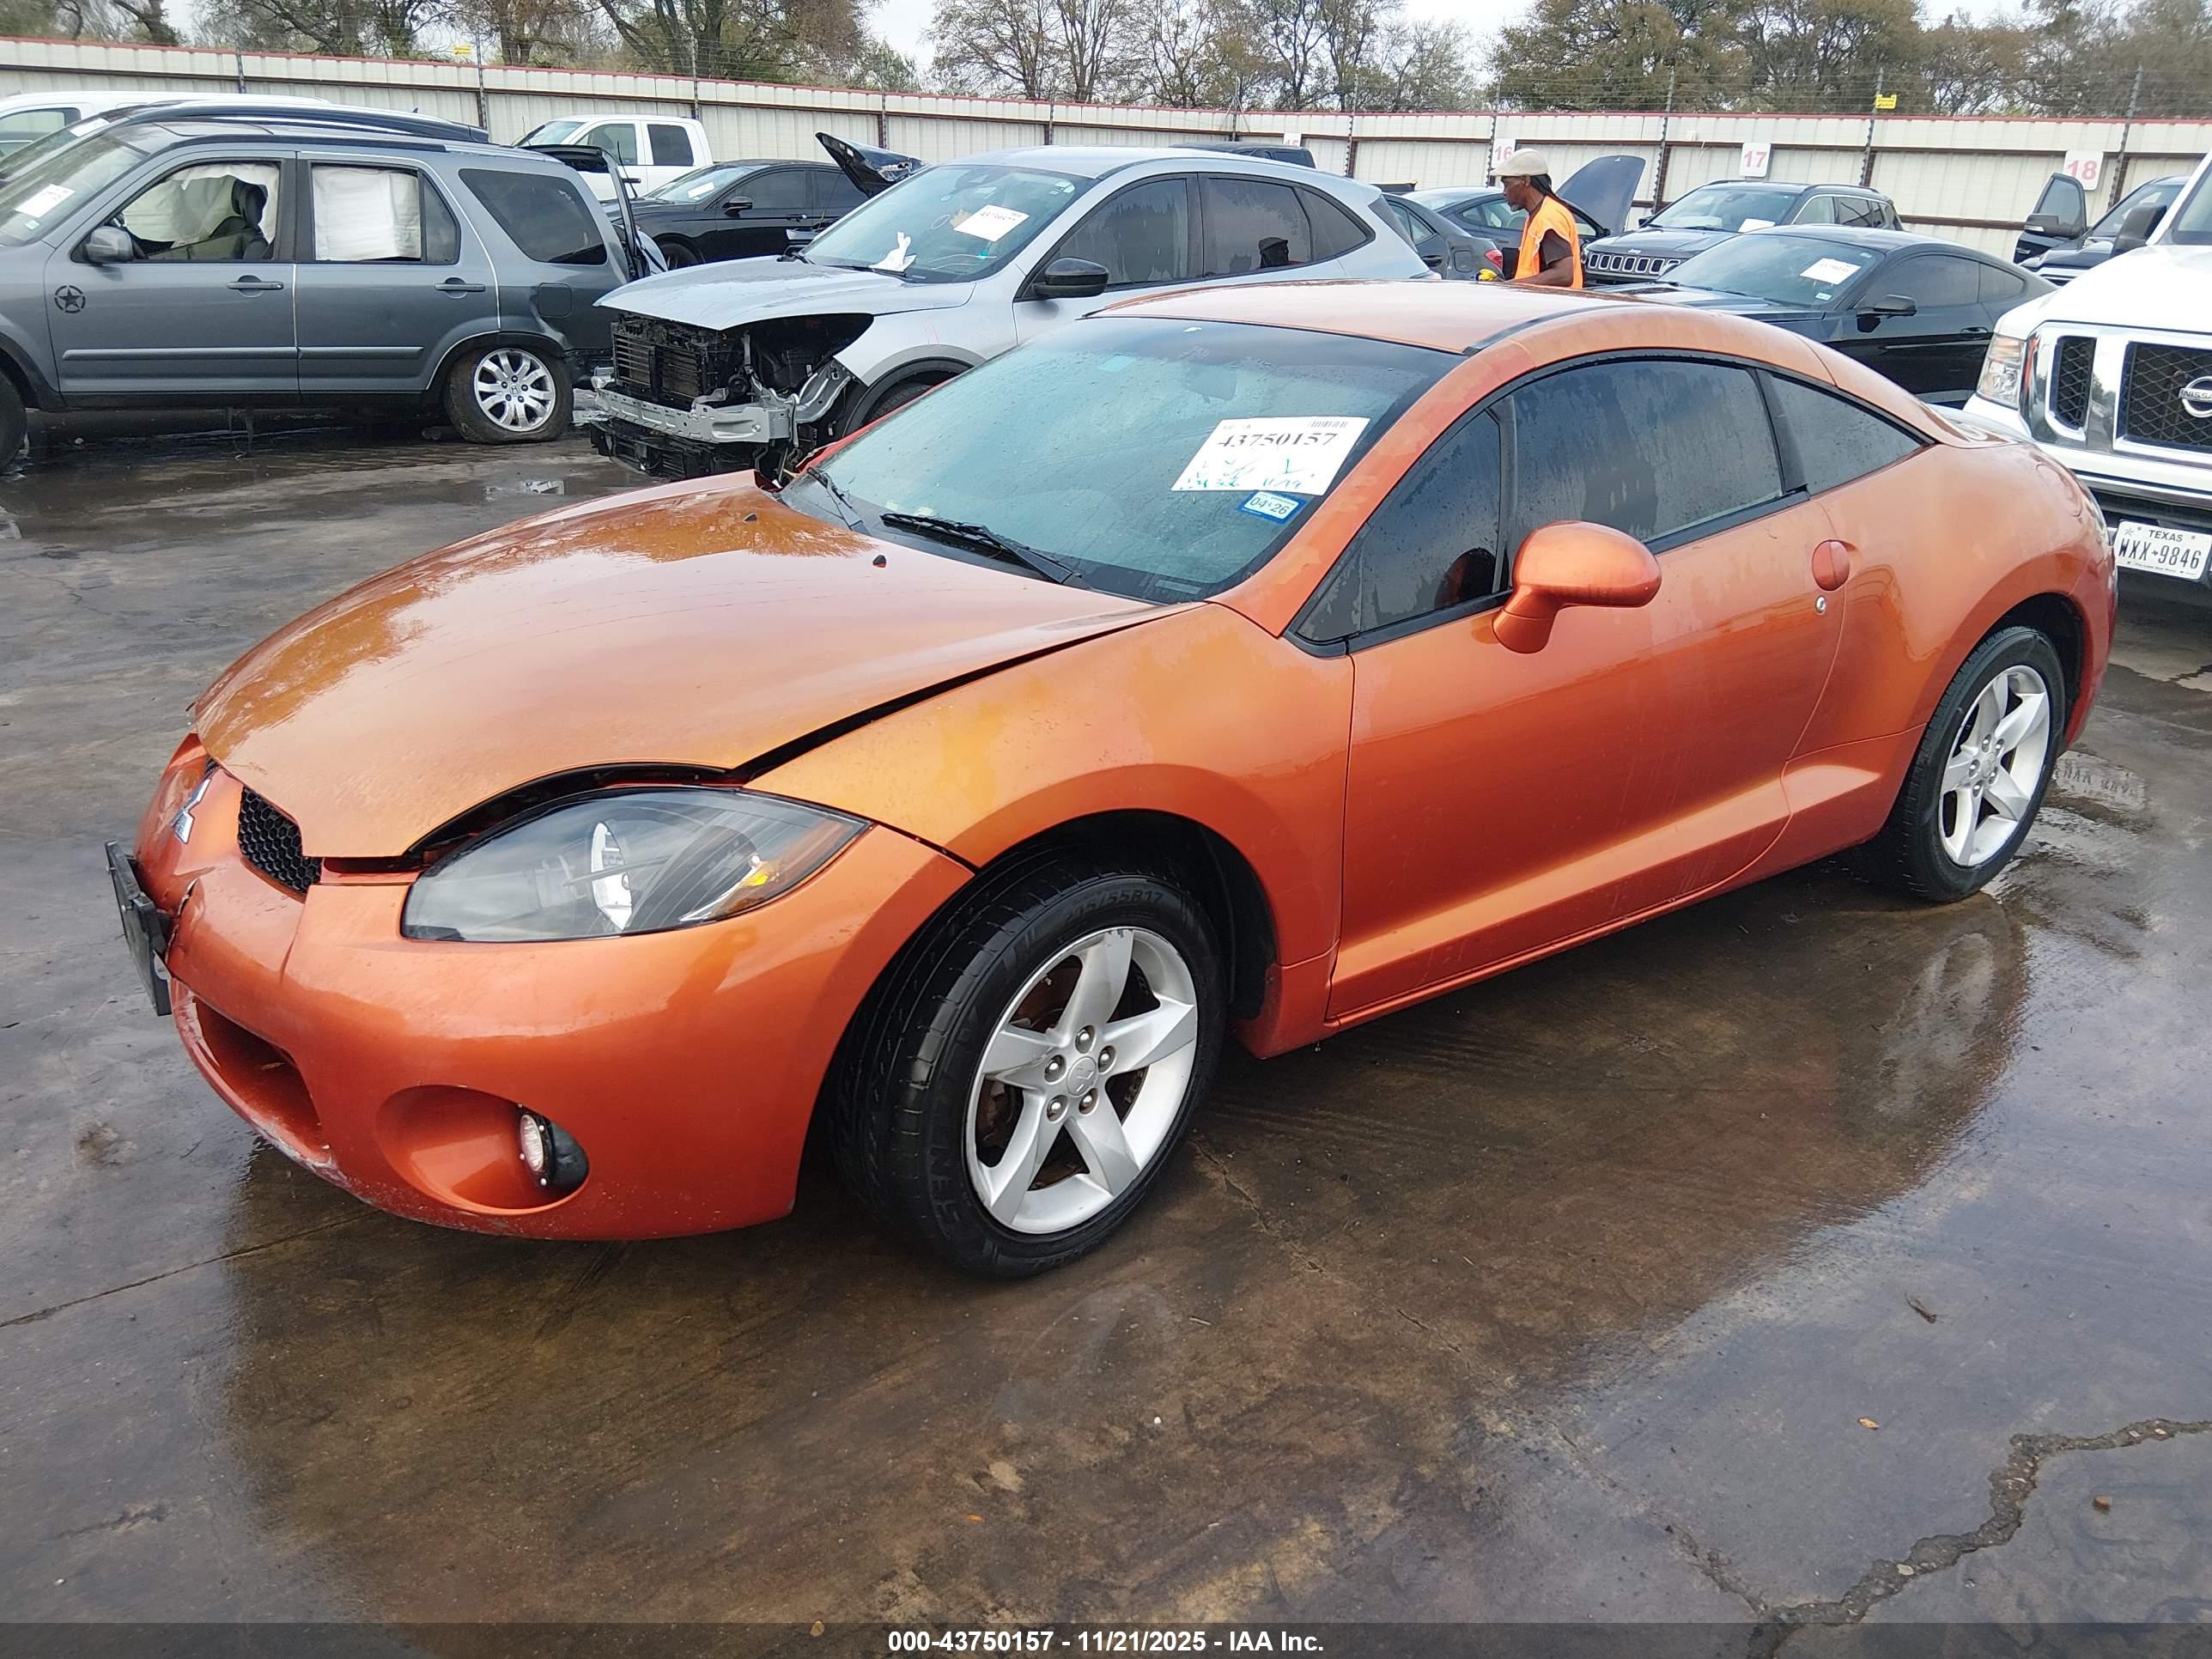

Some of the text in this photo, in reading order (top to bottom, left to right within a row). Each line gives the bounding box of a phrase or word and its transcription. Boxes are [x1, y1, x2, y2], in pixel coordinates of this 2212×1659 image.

[1744, 151, 1766, 167] 17
[2068, 160, 2097, 179] 18
[1216, 433, 1338, 447] 43750157
[2148, 530, 2184, 542] TEXAS
